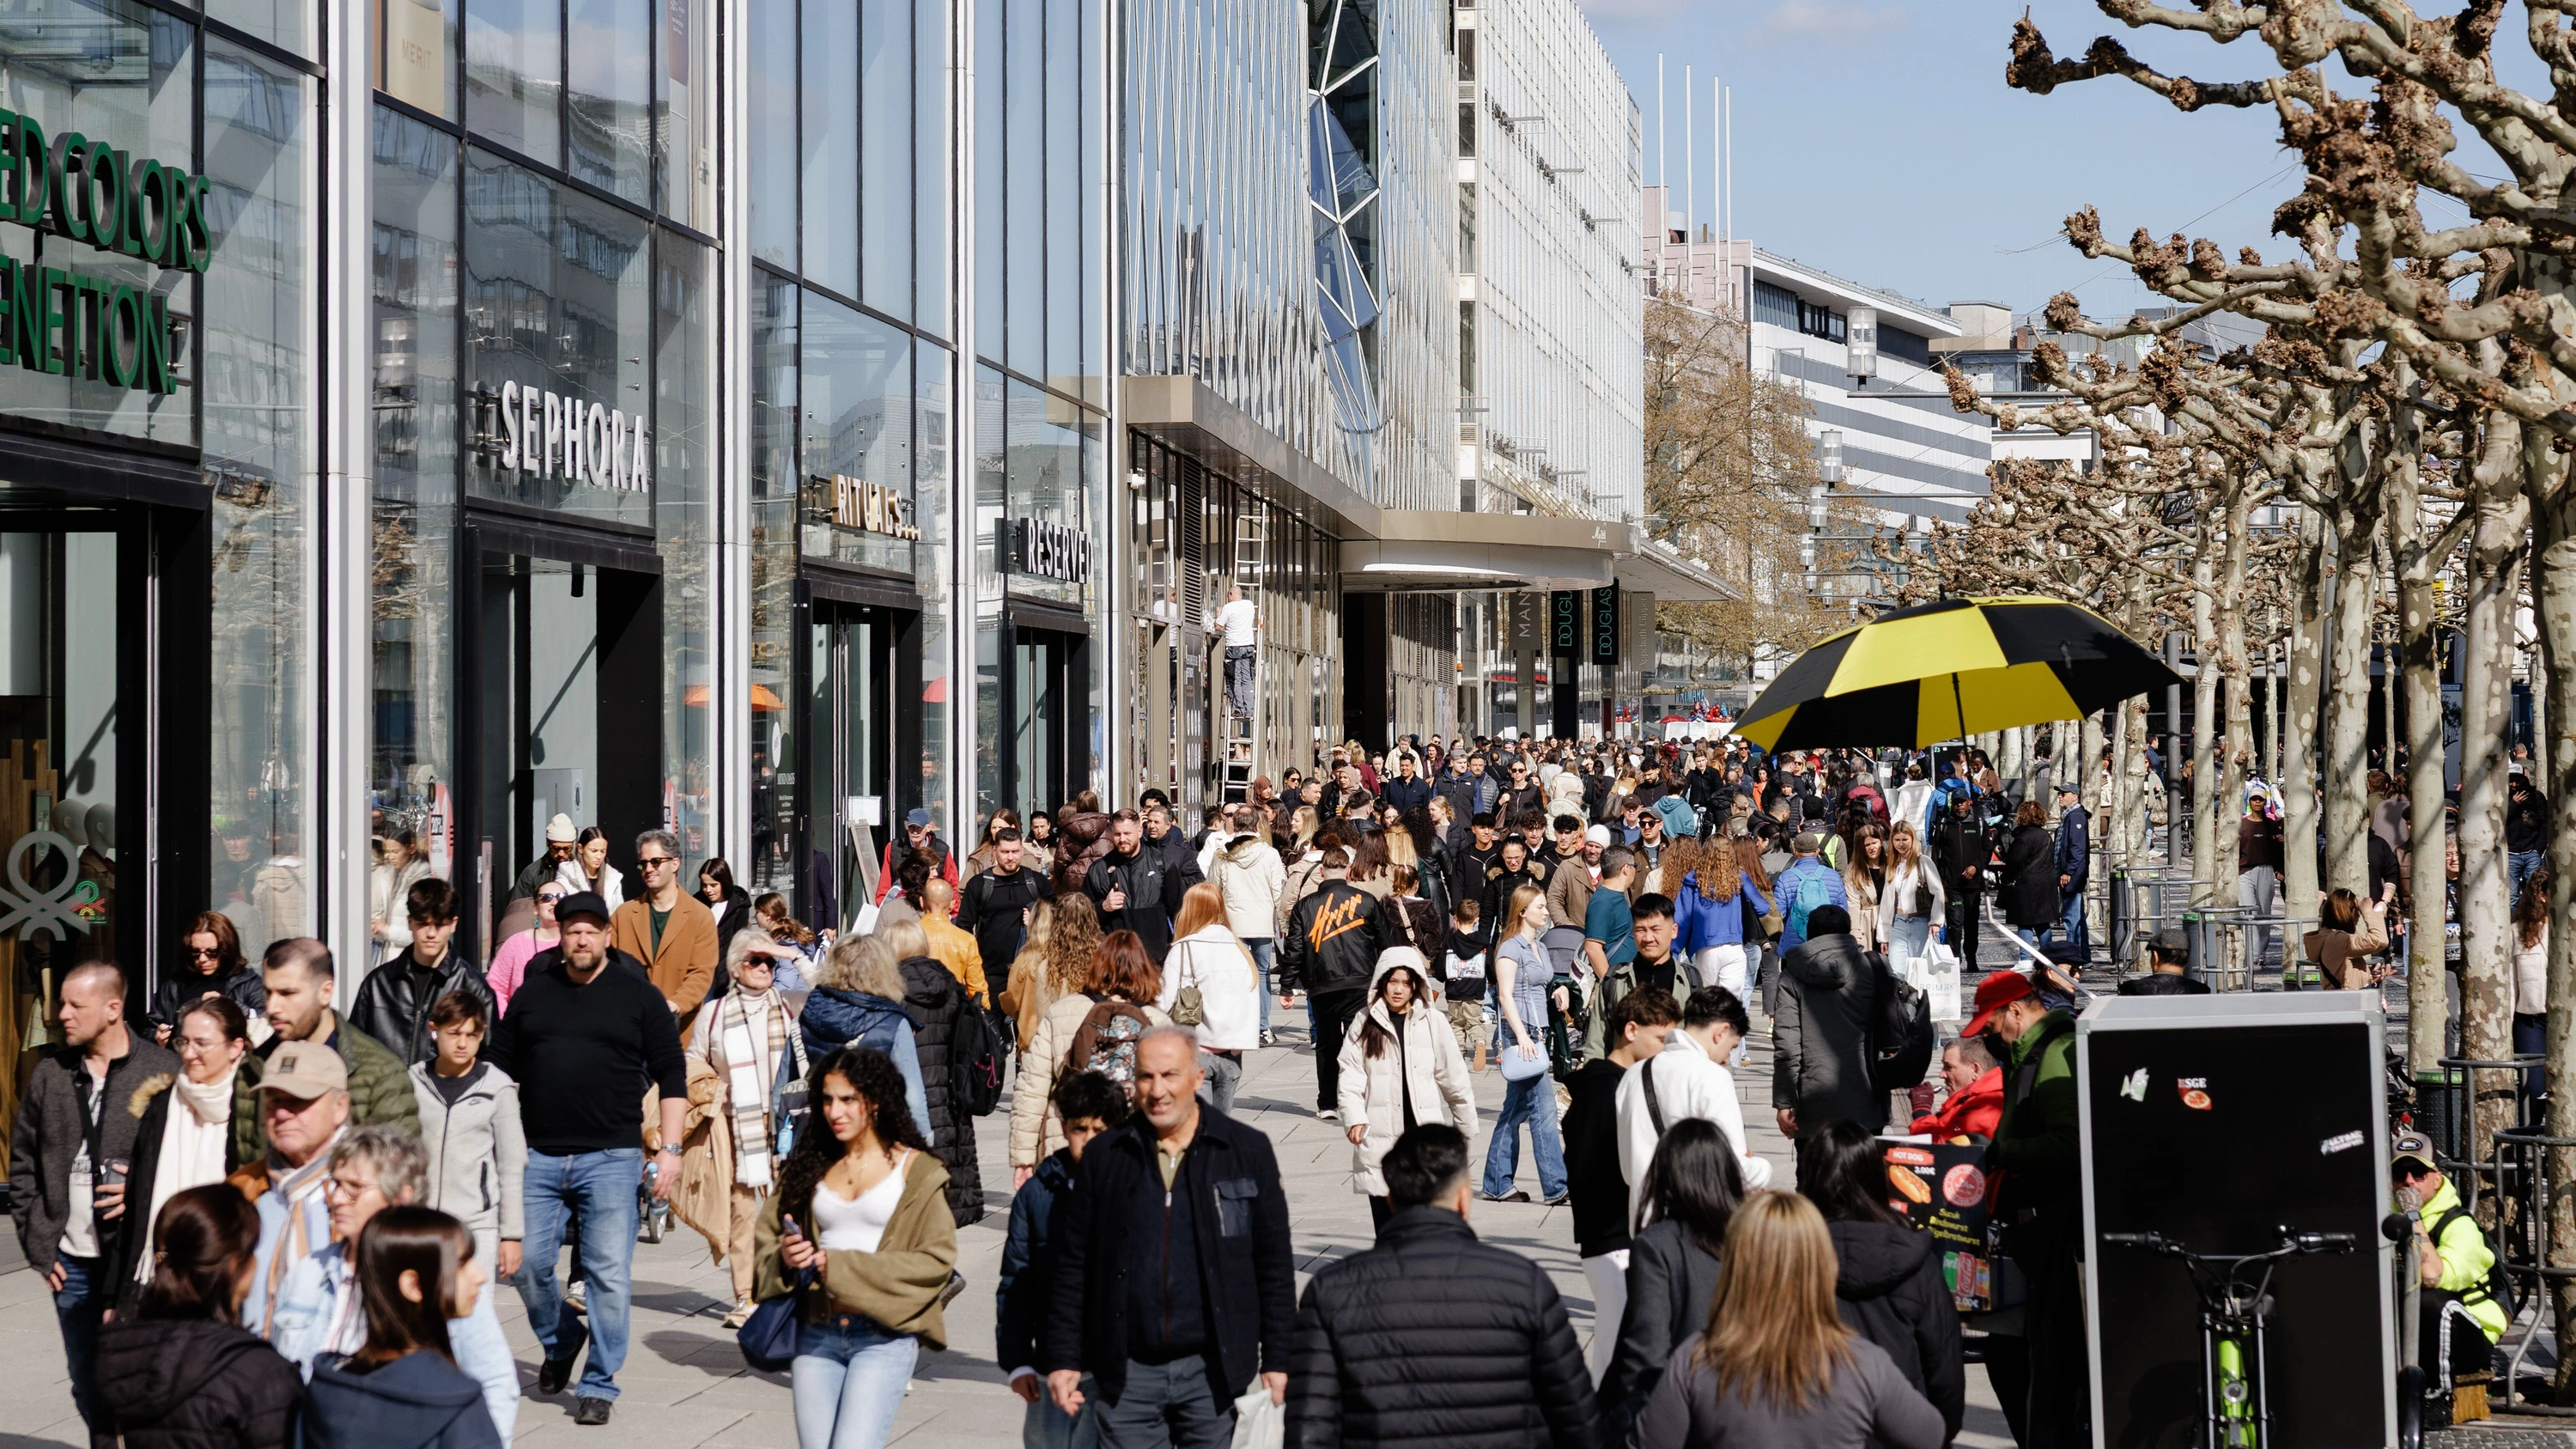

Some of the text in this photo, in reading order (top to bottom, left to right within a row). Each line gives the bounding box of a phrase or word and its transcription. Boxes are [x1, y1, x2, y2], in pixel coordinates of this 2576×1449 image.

[402, 38, 432, 70] MERIT
[49, 131, 211, 273] COLORS
[502, 380, 648, 492] SEPHORA
[1028, 517, 1093, 585] RESERVED
[1558, 590, 1573, 647] DOUGL
[1599, 588, 1613, 656] DOUGLAS
[2184, 1077, 2207, 1088] SGE
[1893, 1151, 1923, 1162] HOT DOG
[1938, 1208, 1961, 1220] Sucuk
